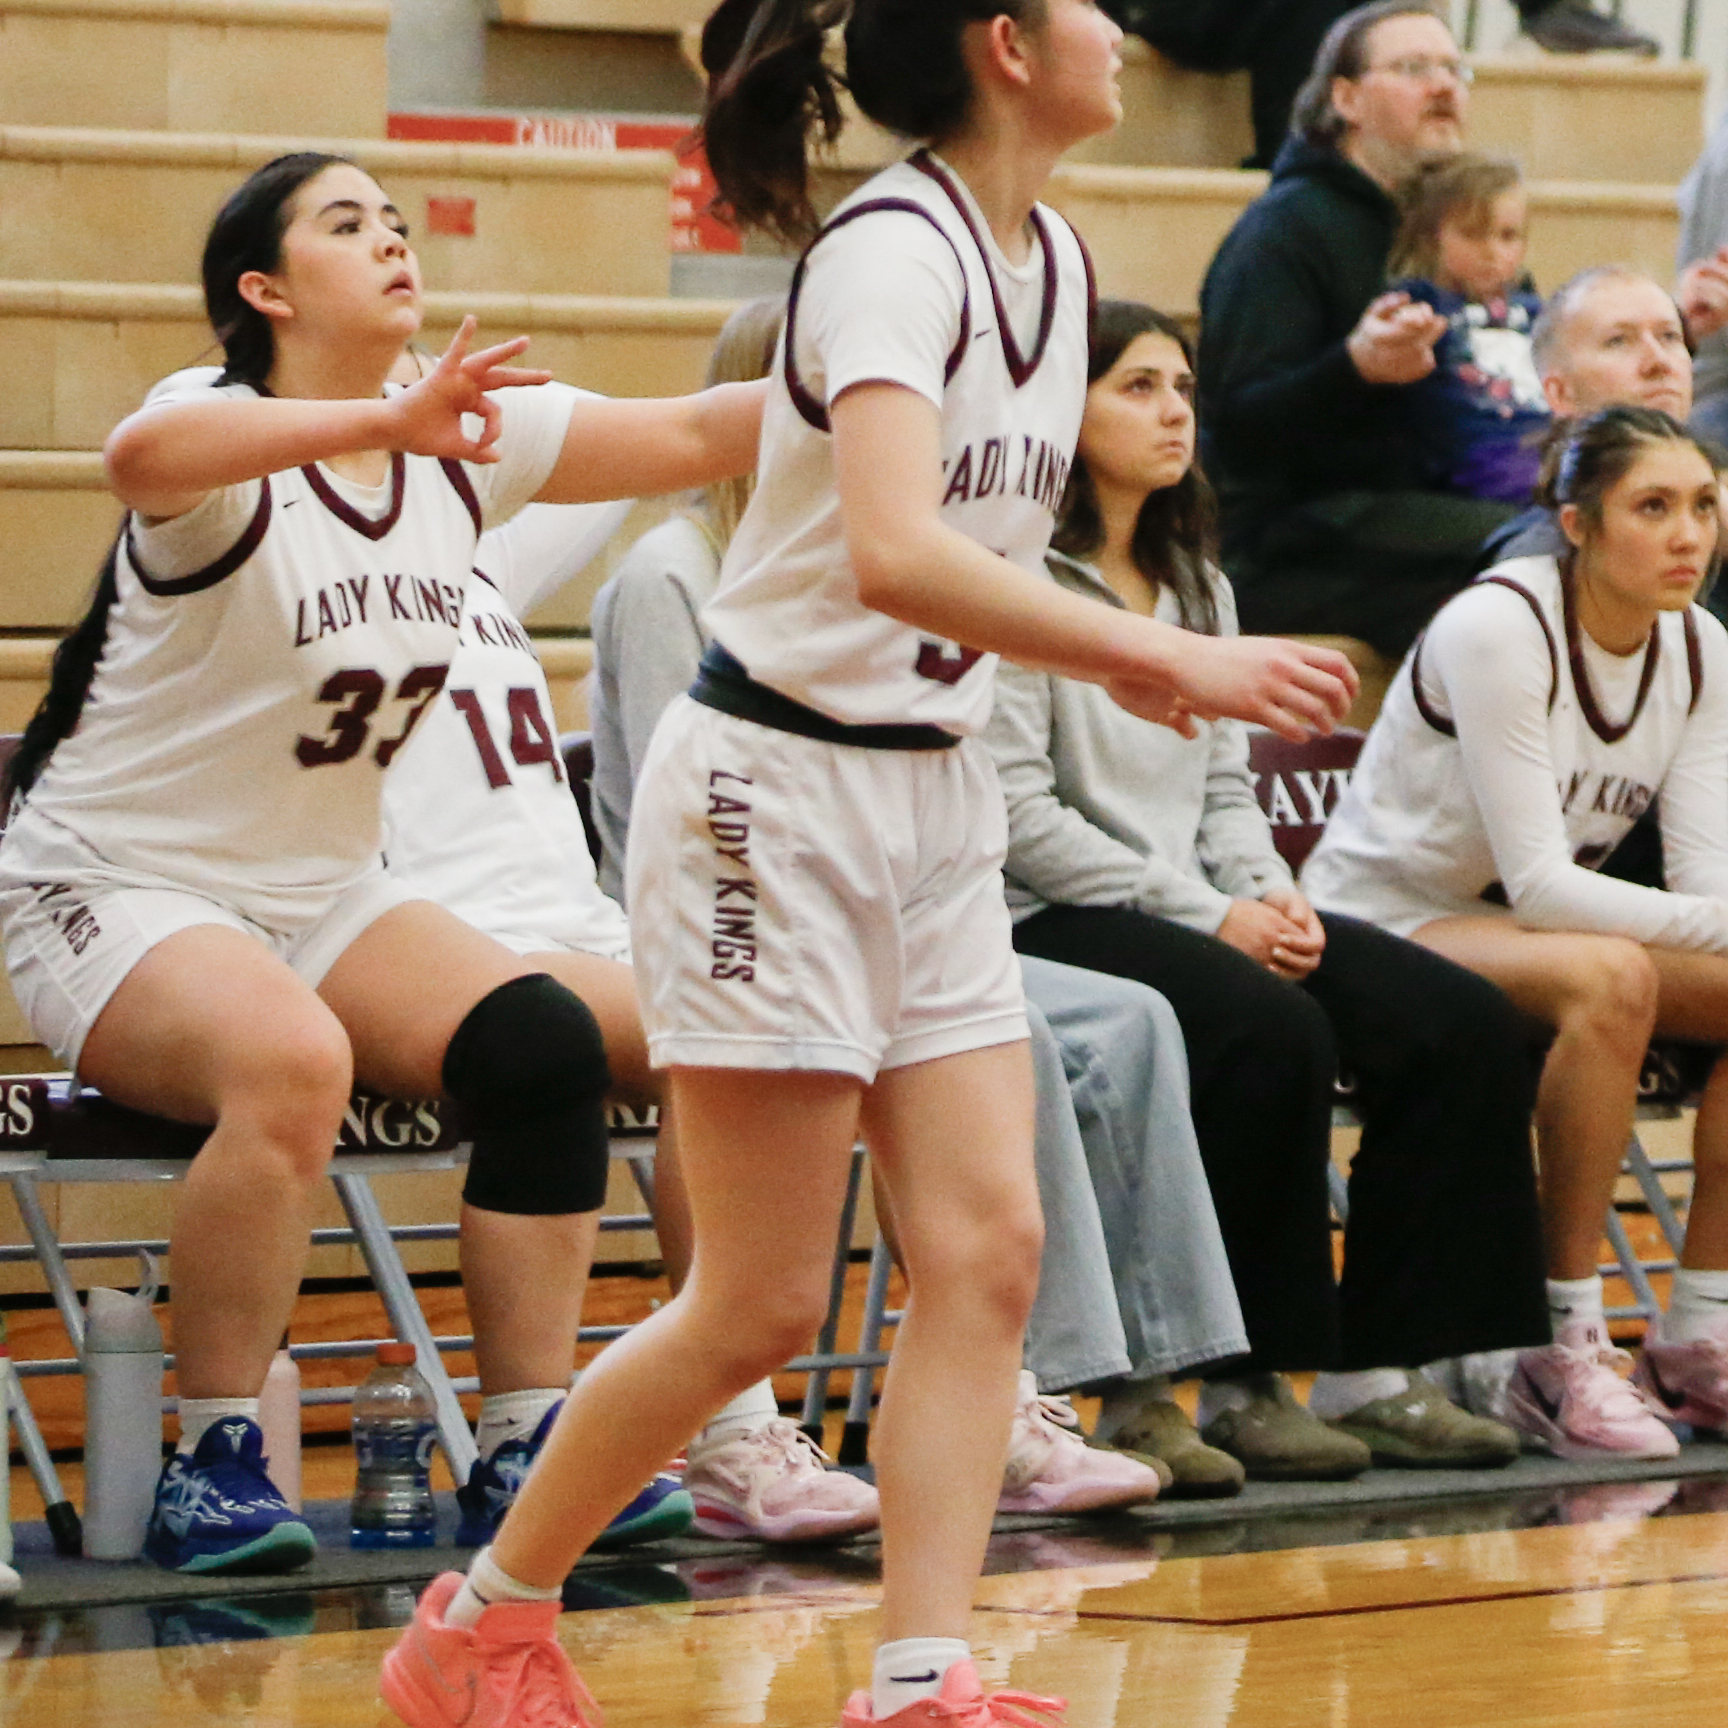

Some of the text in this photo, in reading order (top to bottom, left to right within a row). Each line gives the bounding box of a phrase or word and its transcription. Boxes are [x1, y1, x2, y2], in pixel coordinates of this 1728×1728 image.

[295, 574, 368, 648] LADY
[450, 687, 563, 790] 14
[708, 769, 753, 867] LADY
[711, 878, 758, 983] KINGS
